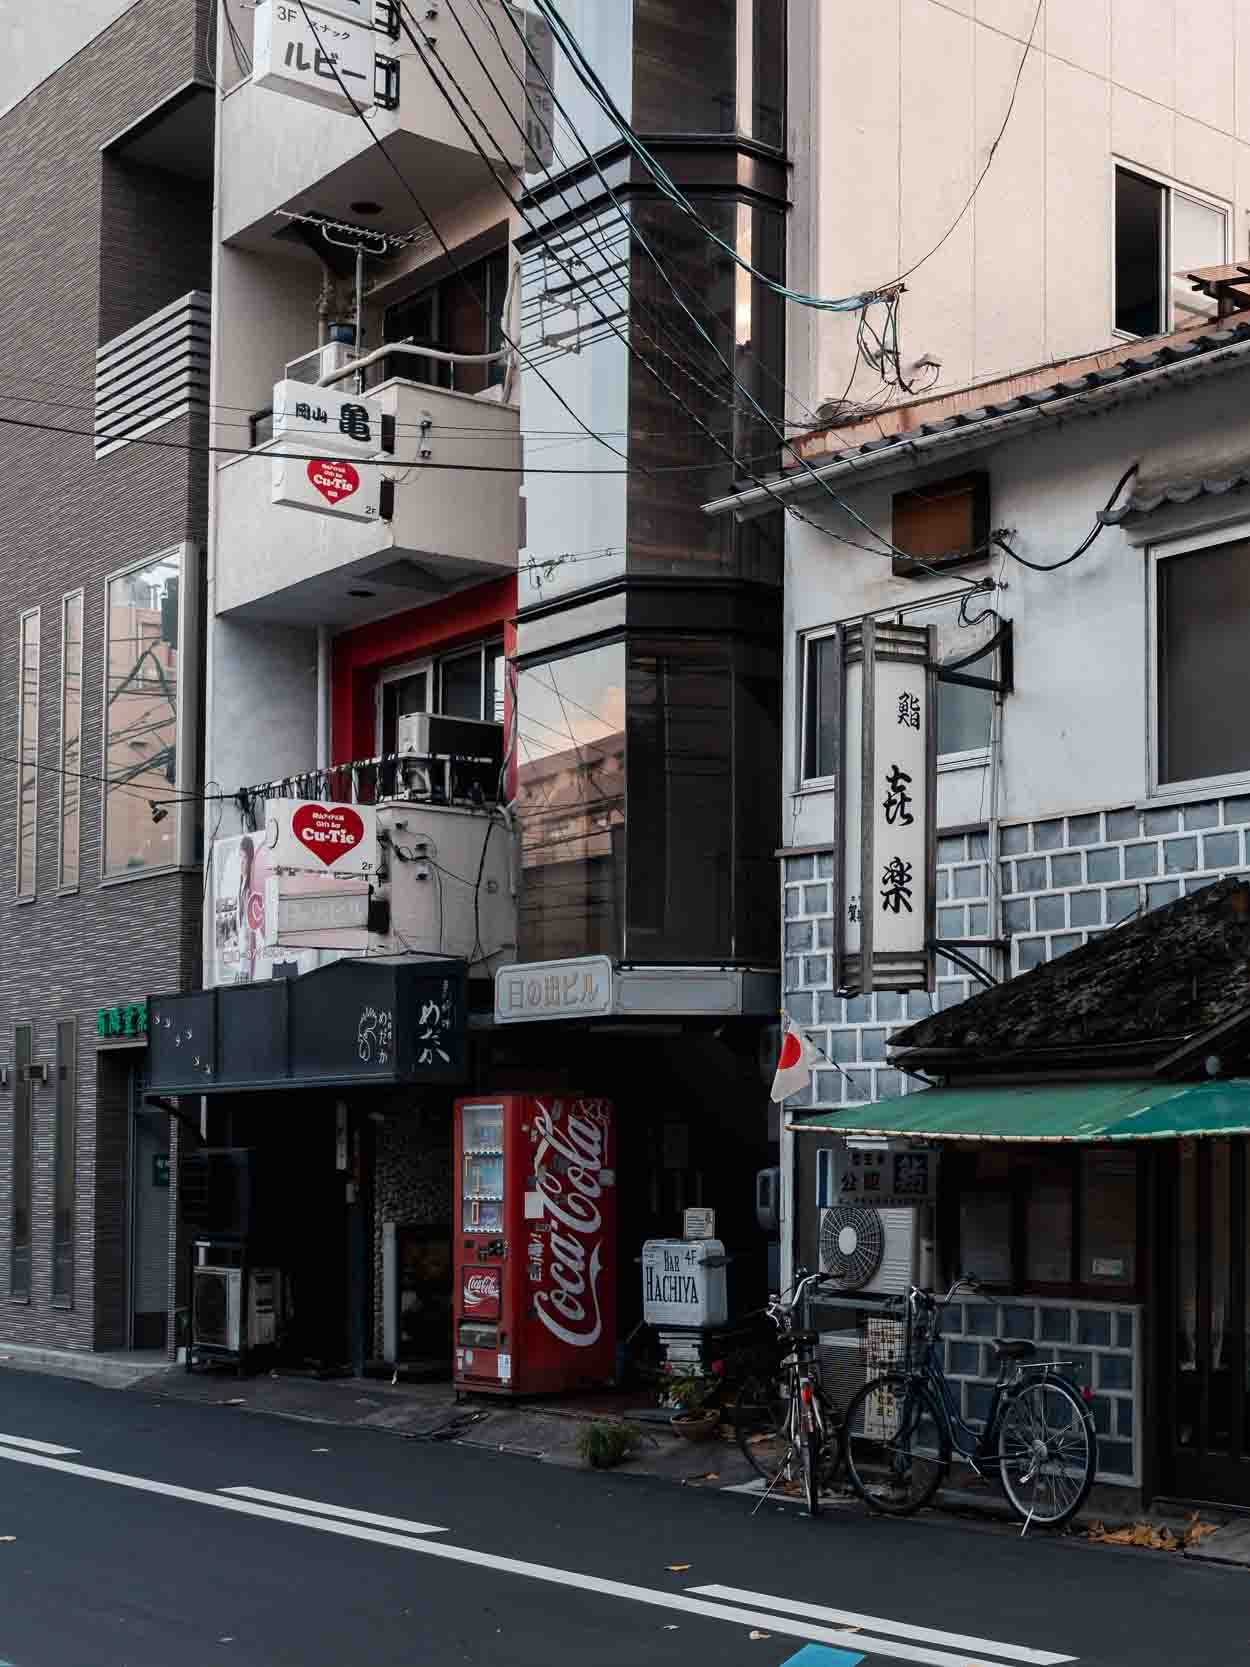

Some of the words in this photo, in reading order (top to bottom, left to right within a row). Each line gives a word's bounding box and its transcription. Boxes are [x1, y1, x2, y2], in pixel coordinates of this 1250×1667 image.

[277, 6, 297, 23] 3F
[284, 41, 367, 81] ルビー
[896, 690, 922, 732] 鮨
[301, 826, 356, 845] Cu-Tie
[533, 1100, 604, 1346] Coca-Cola
[664, 1251, 680, 1272] BAR
[645, 1266, 699, 1304] HACHIYA
